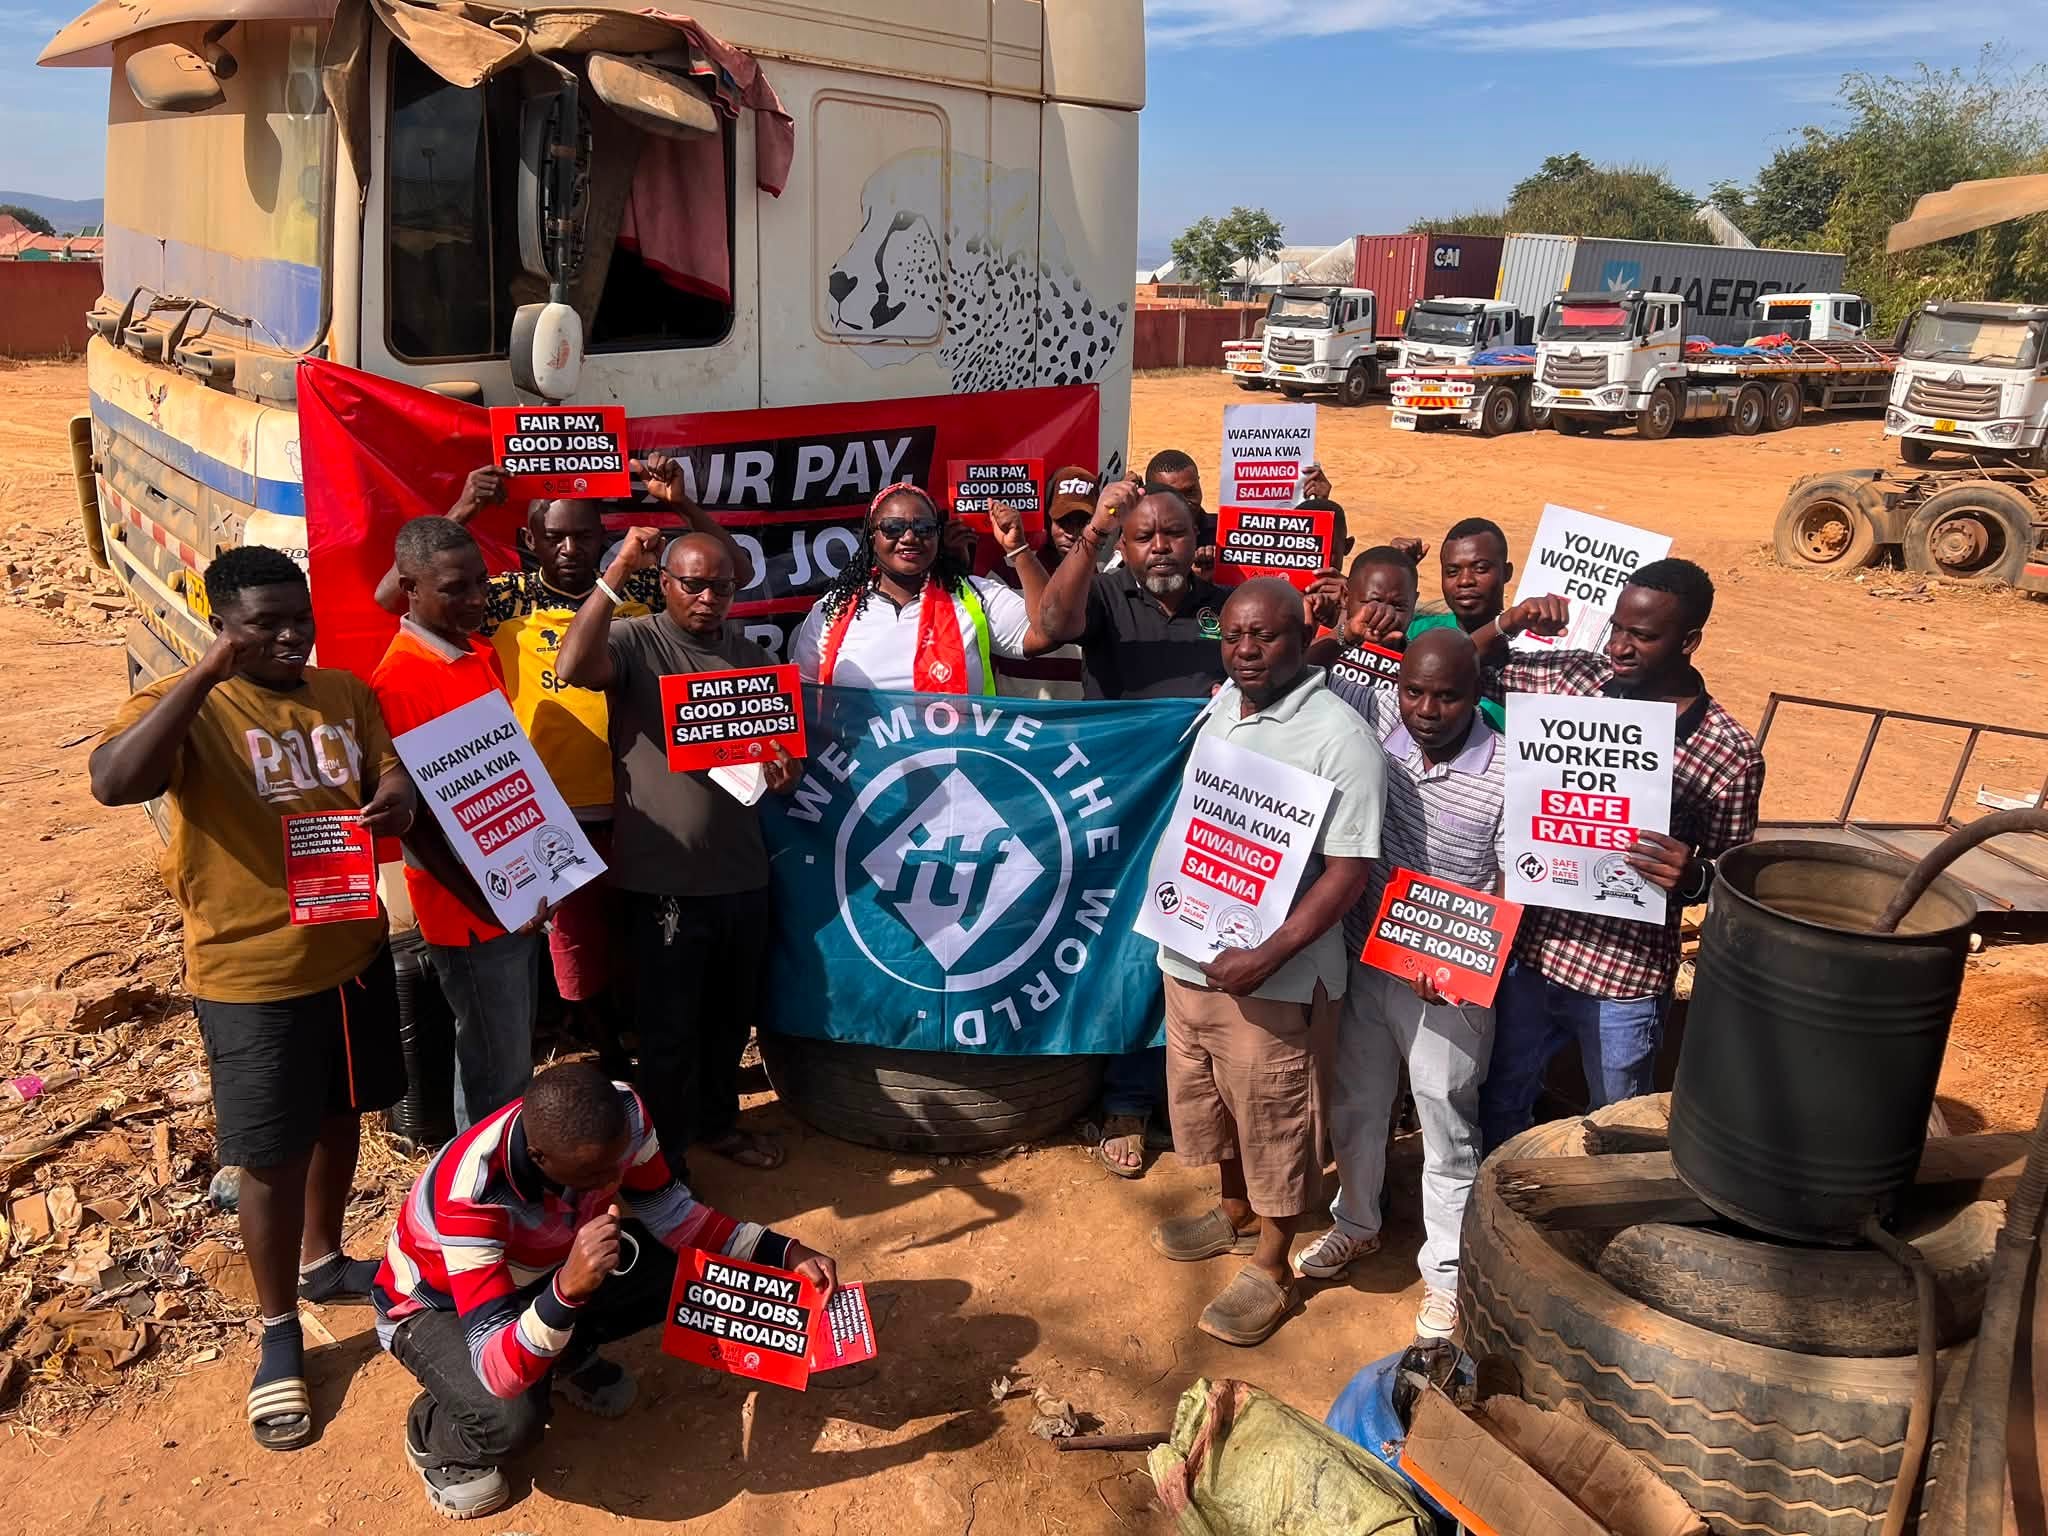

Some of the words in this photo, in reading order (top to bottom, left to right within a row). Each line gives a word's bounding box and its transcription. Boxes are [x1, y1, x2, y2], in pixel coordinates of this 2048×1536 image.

[1434, 248, 1460, 267] CAI
[520, 416, 560, 431] FAIR
[564, 415, 600, 432] PAY,
[1228, 428, 1310, 440] WAFANYAKAZI
[508, 437, 562, 452] GOOD
[566, 436, 614, 452] JOBS,
[1232, 447, 1272, 458] VIJANA
[1275, 446, 1301, 457] KWA
[505, 457, 551, 473] SAFE
[555, 455, 620, 471] ROADS!
[603, 450, 774, 504] AIR
[970, 467, 998, 479] FAIR
[1001, 466, 1026, 479] PAY,
[1237, 465, 1296, 477] VIWANGO
[960, 483, 999, 495] GOOD
[1001, 483, 1035, 496] JOBS,
[1058, 478, 1094, 495] star
[1239, 487, 1290, 498] SALAMA
[956, 499, 989, 512] SAFE
[996, 498, 1038, 510] ADS!
[1242, 515, 1277, 529] FAIR
[1279, 518, 1310, 534] PAY,
[1229, 533, 1275, 547] GOOD
[1277, 535, 1319, 552] JOBS,
[1564, 531, 1640, 569] YOUNG
[1223, 550, 1262, 564] SAFE
[1264, 553, 1322, 568] ROADS!
[1540, 548, 1632, 589] WORKER
[1564, 579, 1607, 606] FOR
[692, 680, 733, 698] FAIR
[737, 676, 774, 694] PAY,
[1333, 664, 1370, 686] OOD
[680, 702, 736, 721] GOOD
[740, 697, 788, 715] JOBS,
[676, 724, 724, 742] SAFE
[728, 716, 795, 737] ROADS!
[868, 702, 1043, 751] MOVE
[1540, 718, 1642, 746] YOUNG
[416, 722, 517, 782] WAFANYAKAZI
[1518, 741, 1659, 772] WORKERS
[435, 769, 486, 802] VIJANA
[486, 750, 520, 778] KWA
[787, 742, 861, 824] WE
[1561, 770, 1617, 793] FOR
[457, 777, 528, 826] VIWANGO
[1052, 742, 1119, 859] THE
[1194, 768, 1315, 828] WAFANYAKAZI
[1547, 793, 1622, 821] SAFE
[478, 807, 541, 851] SALAMA
[1193, 795, 1246, 830] VIJANA
[1250, 819, 1291, 848] KWA
[1538, 819, 1631, 850] RATES
[331, 845, 361, 853] SALAMA
[1191, 824, 1275, 873] VIWANGO
[1552, 858, 1578, 869] SAFE
[1552, 870, 1578, 880] RATES
[1185, 856, 1257, 900] SALAMA
[1409, 884, 1449, 909] FAIR
[1452, 897, 1489, 924] PAY,
[1391, 902, 1442, 930] GOOD
[1444, 919, 1495, 951] JOBS,
[1379, 921, 1424, 948] SAFE
[1424, 937, 1496, 973] ROADS!
[953, 888, 1117, 1046] WORLD
[706, 1264, 750, 1290] FAIR
[754, 1276, 794, 1302] PAY,
[688, 1285, 746, 1313] GOOD
[749, 1300, 803, 1330] JOBS,
[677, 1307, 726, 1335] SAFE
[729, 1320, 805, 1354] ROADS!
